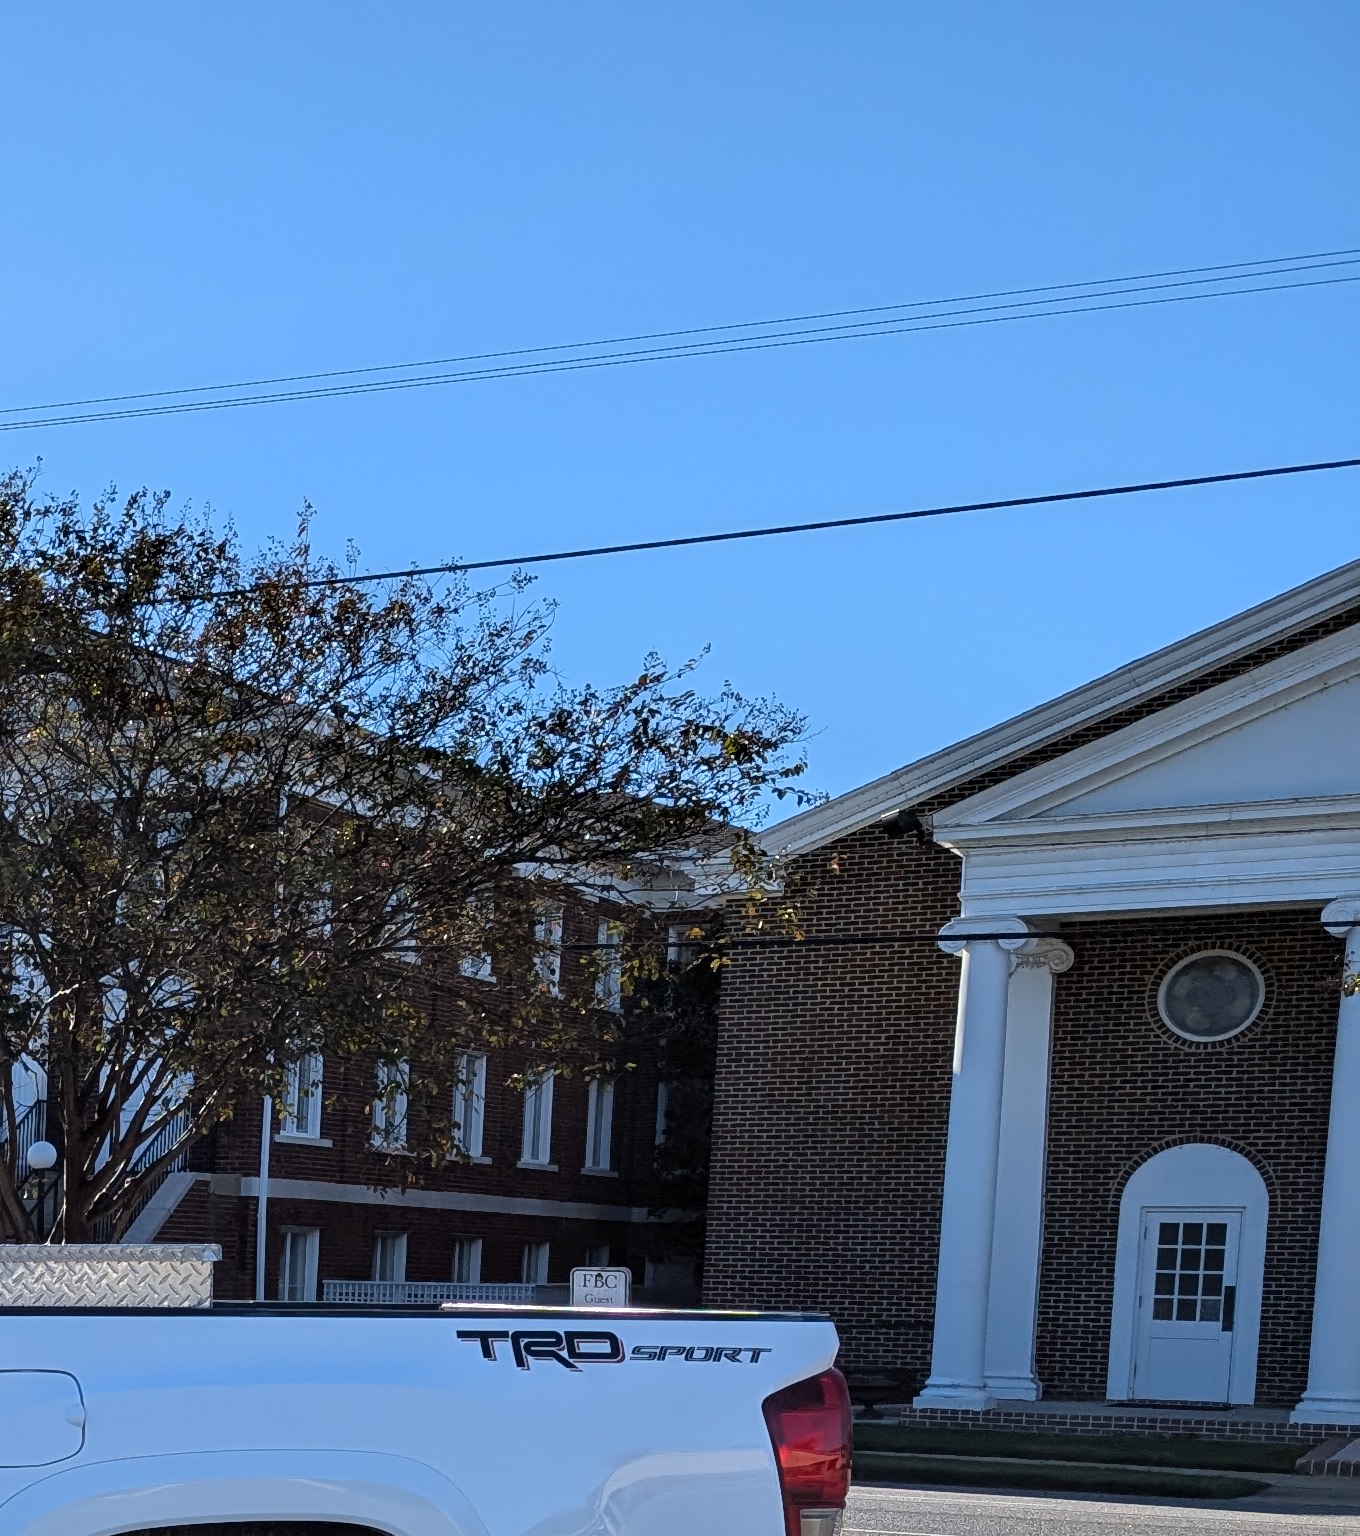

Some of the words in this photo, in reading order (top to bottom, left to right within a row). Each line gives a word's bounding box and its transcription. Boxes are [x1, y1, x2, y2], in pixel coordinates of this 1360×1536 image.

[582, 1273, 618, 1289] FBC
[584, 1293, 614, 1304] Guest
[456, 1330, 626, 1373] TRD
[629, 1345, 773, 1364] SPORT
